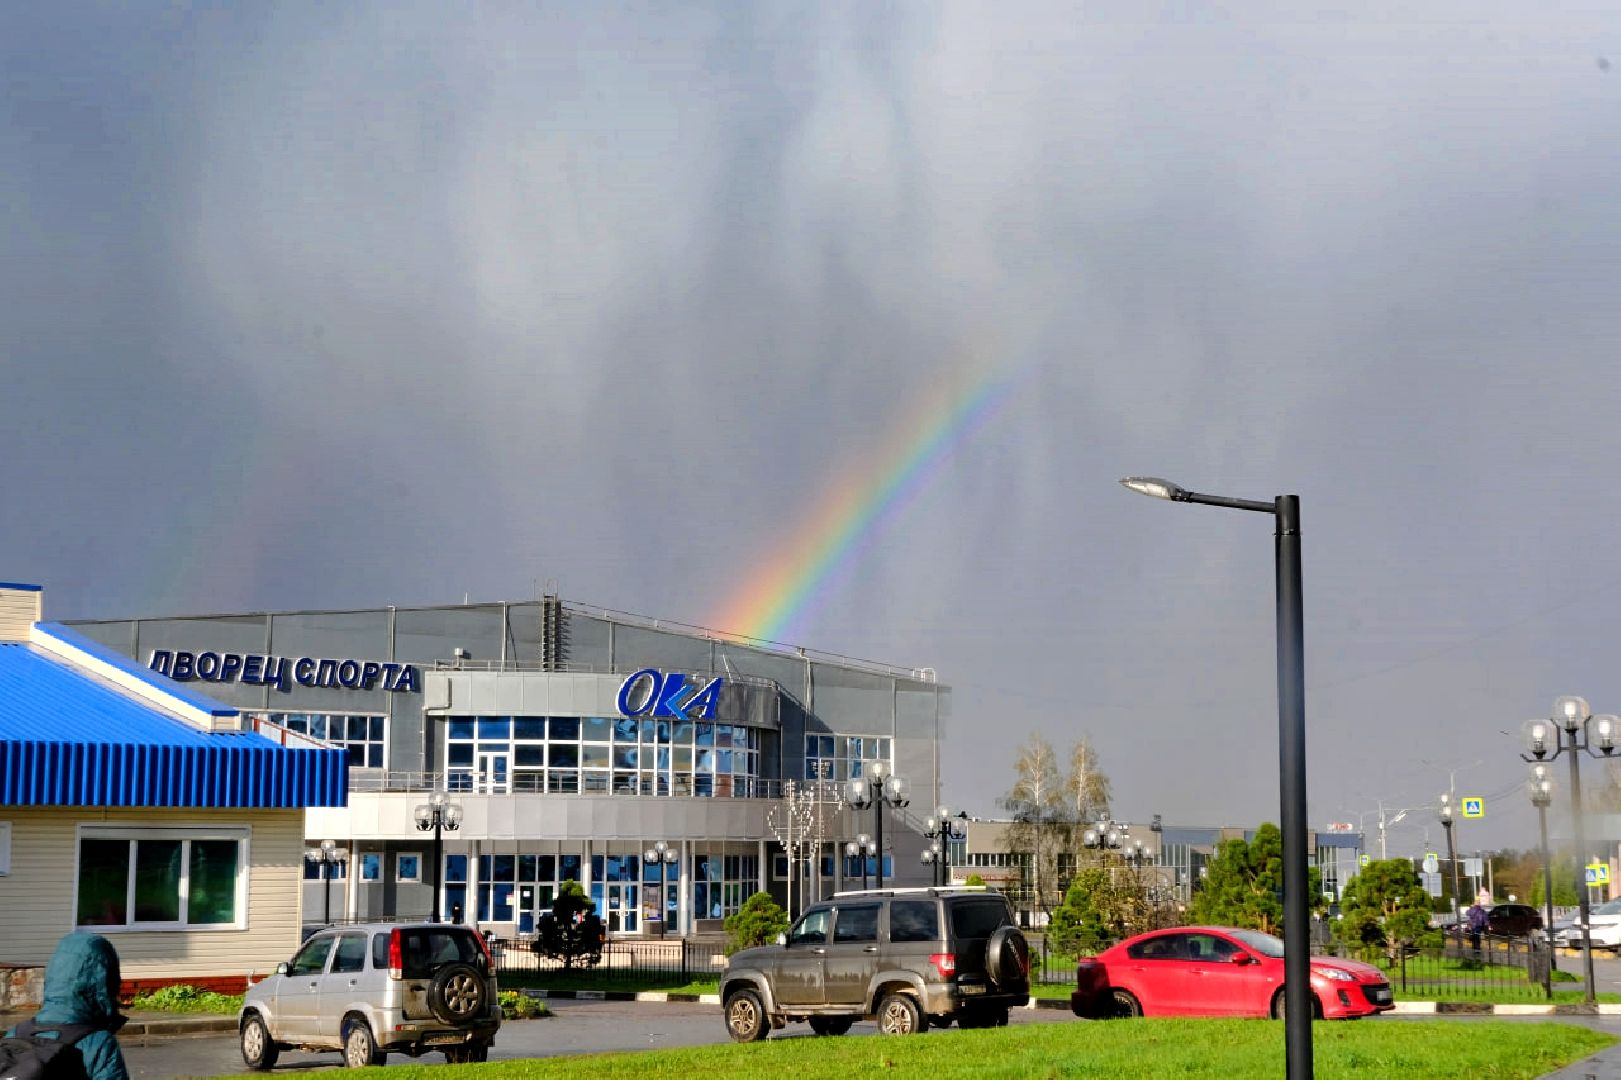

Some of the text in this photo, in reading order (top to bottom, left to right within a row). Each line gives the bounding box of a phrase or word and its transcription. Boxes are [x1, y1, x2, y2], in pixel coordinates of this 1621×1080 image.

[149, 650, 418, 692] ДВОРЕЦ СПОРТА
[615, 668, 724, 720] ОКА
